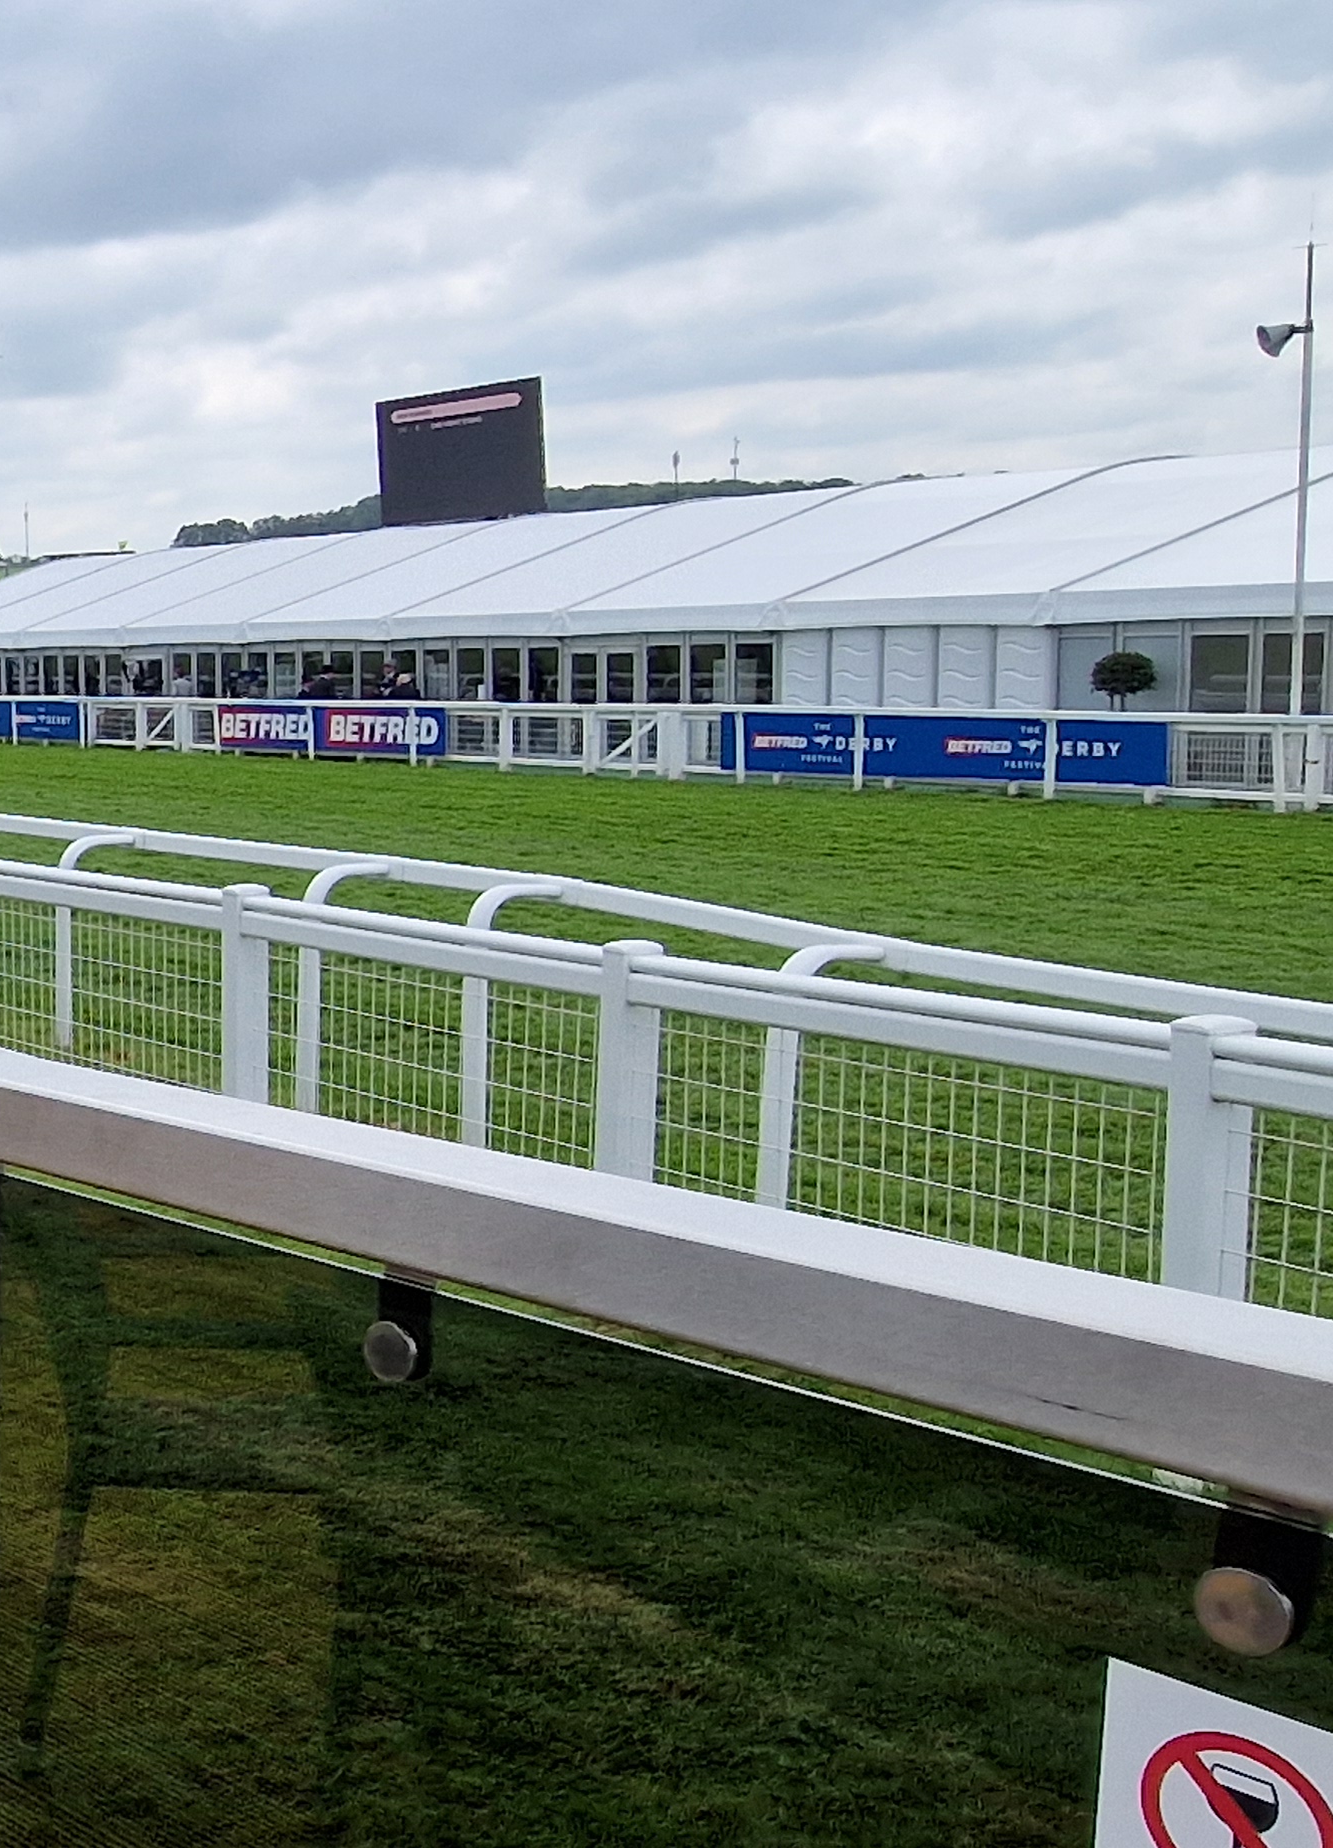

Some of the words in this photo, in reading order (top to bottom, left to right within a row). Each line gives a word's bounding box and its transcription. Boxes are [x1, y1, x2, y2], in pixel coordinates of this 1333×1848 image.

[221, 713, 310, 740] BETFRED
[329, 715, 439, 745] BETFRED
[753, 735, 808, 749] BETFRED
[834, 736, 898, 752] DERBY
[946, 739, 1013, 754] BETFRED
[1055, 740, 1122, 757] ERBY
[1003, 760, 1046, 769] FESTIV
